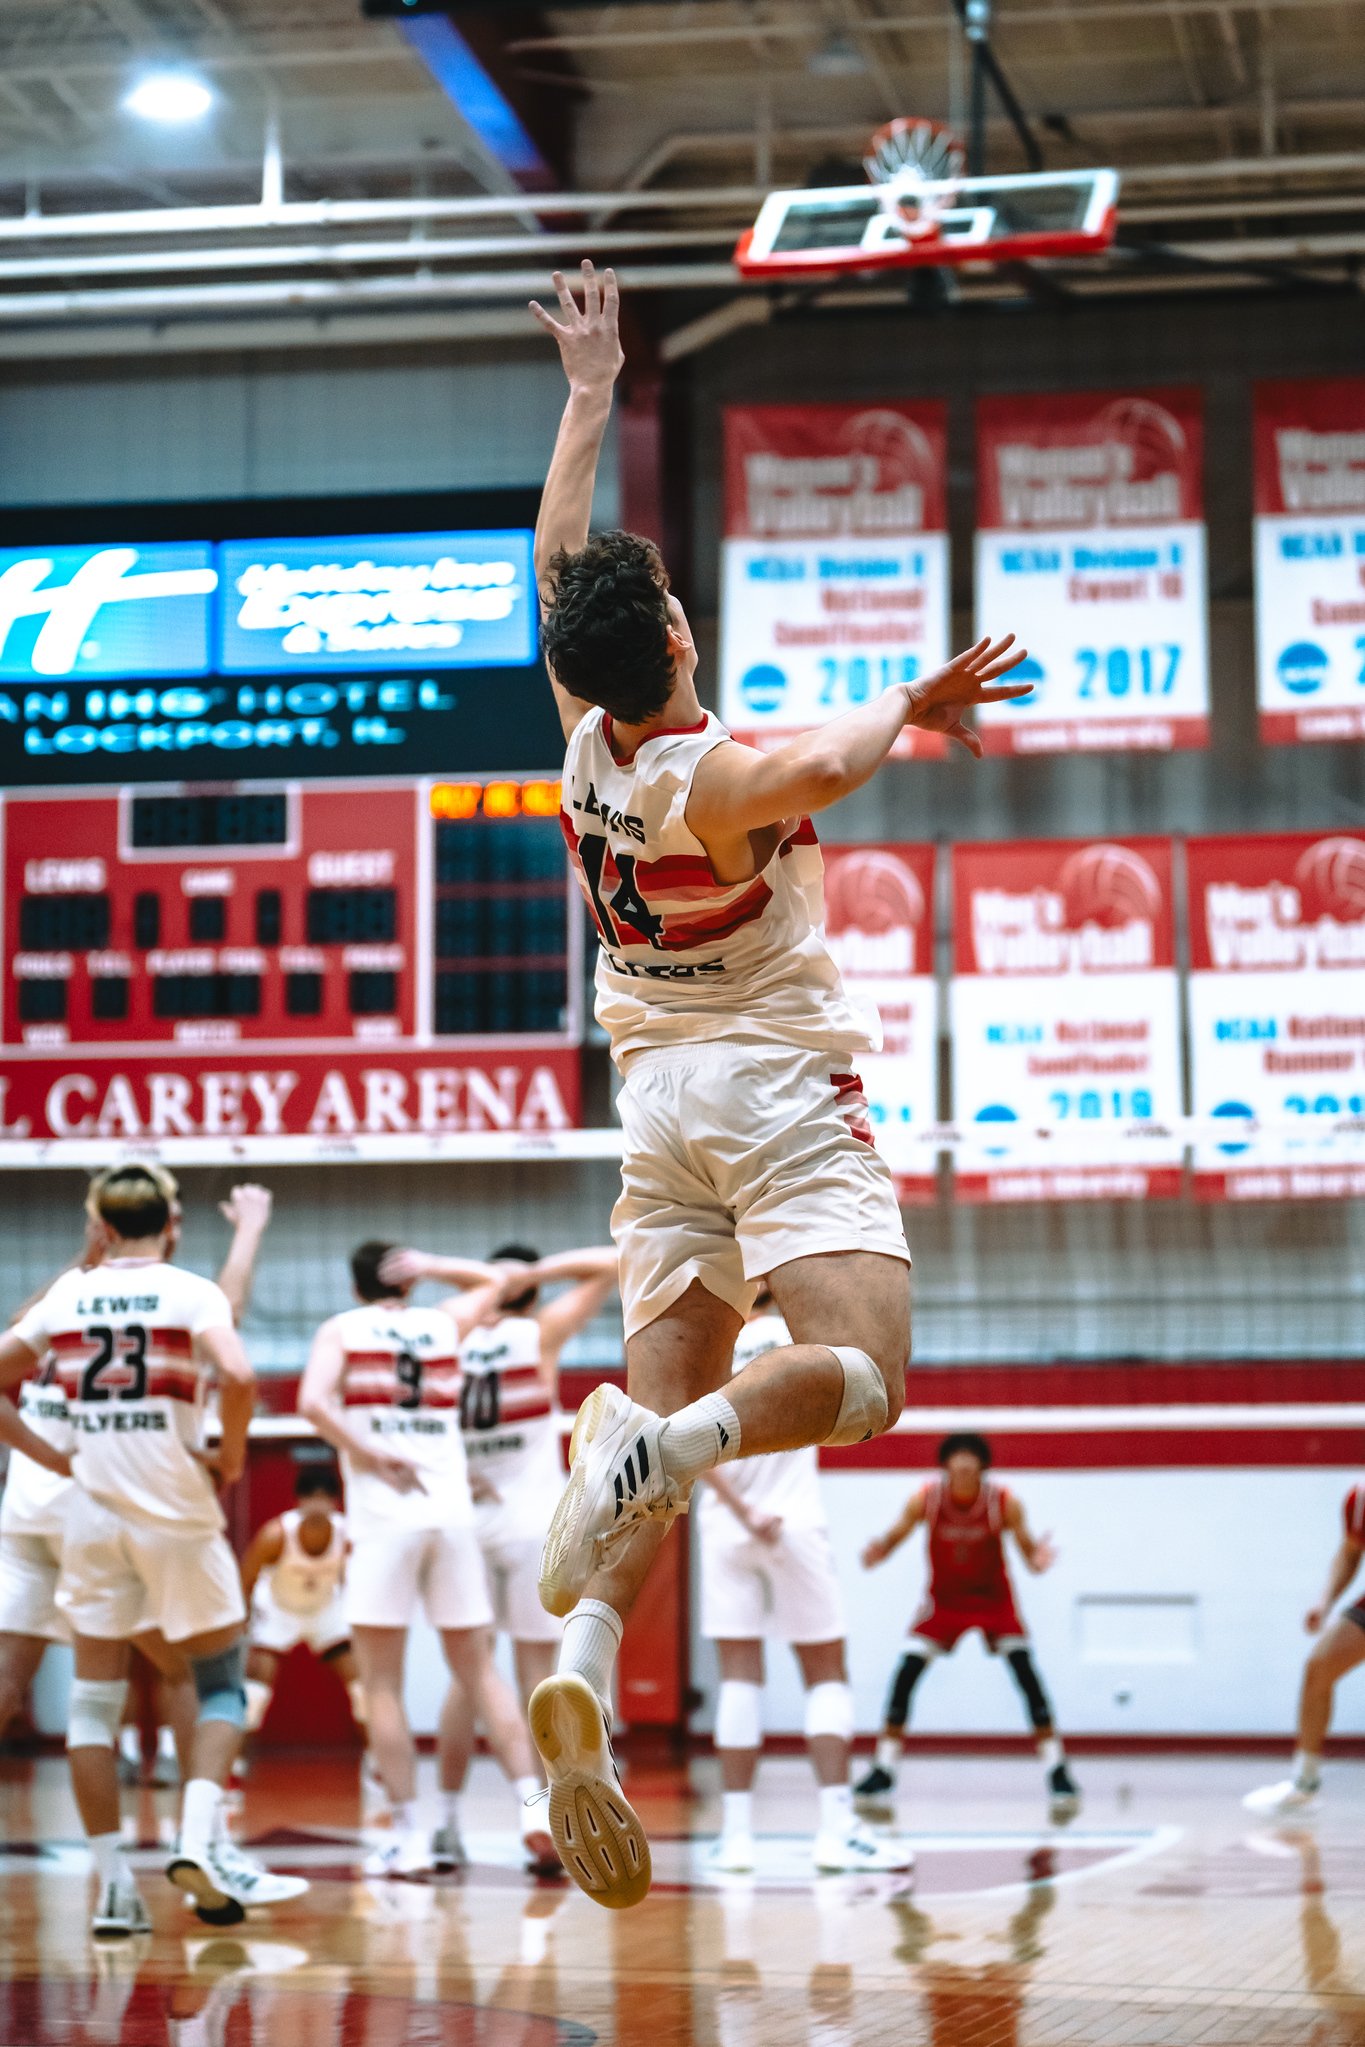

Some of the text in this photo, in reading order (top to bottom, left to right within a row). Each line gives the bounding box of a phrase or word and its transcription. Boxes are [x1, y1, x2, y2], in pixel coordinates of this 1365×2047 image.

[1075, 645, 1183, 699] 2017
[236, 678, 457, 717] HOTEL
[24, 714, 407, 756] LOCKPORT, IL
[24, 856, 107, 894] LEWIS
[307, 850, 396, 888] GUEST
[578, 831, 666, 951] 14
[46, 1069, 298, 1139] CAREY
[309, 1064, 572, 1134] ARENA
[77, 1295, 159, 1315] LEWIS
[81, 1322, 147, 1402] 23
[397, 1351, 422, 1408] 9
